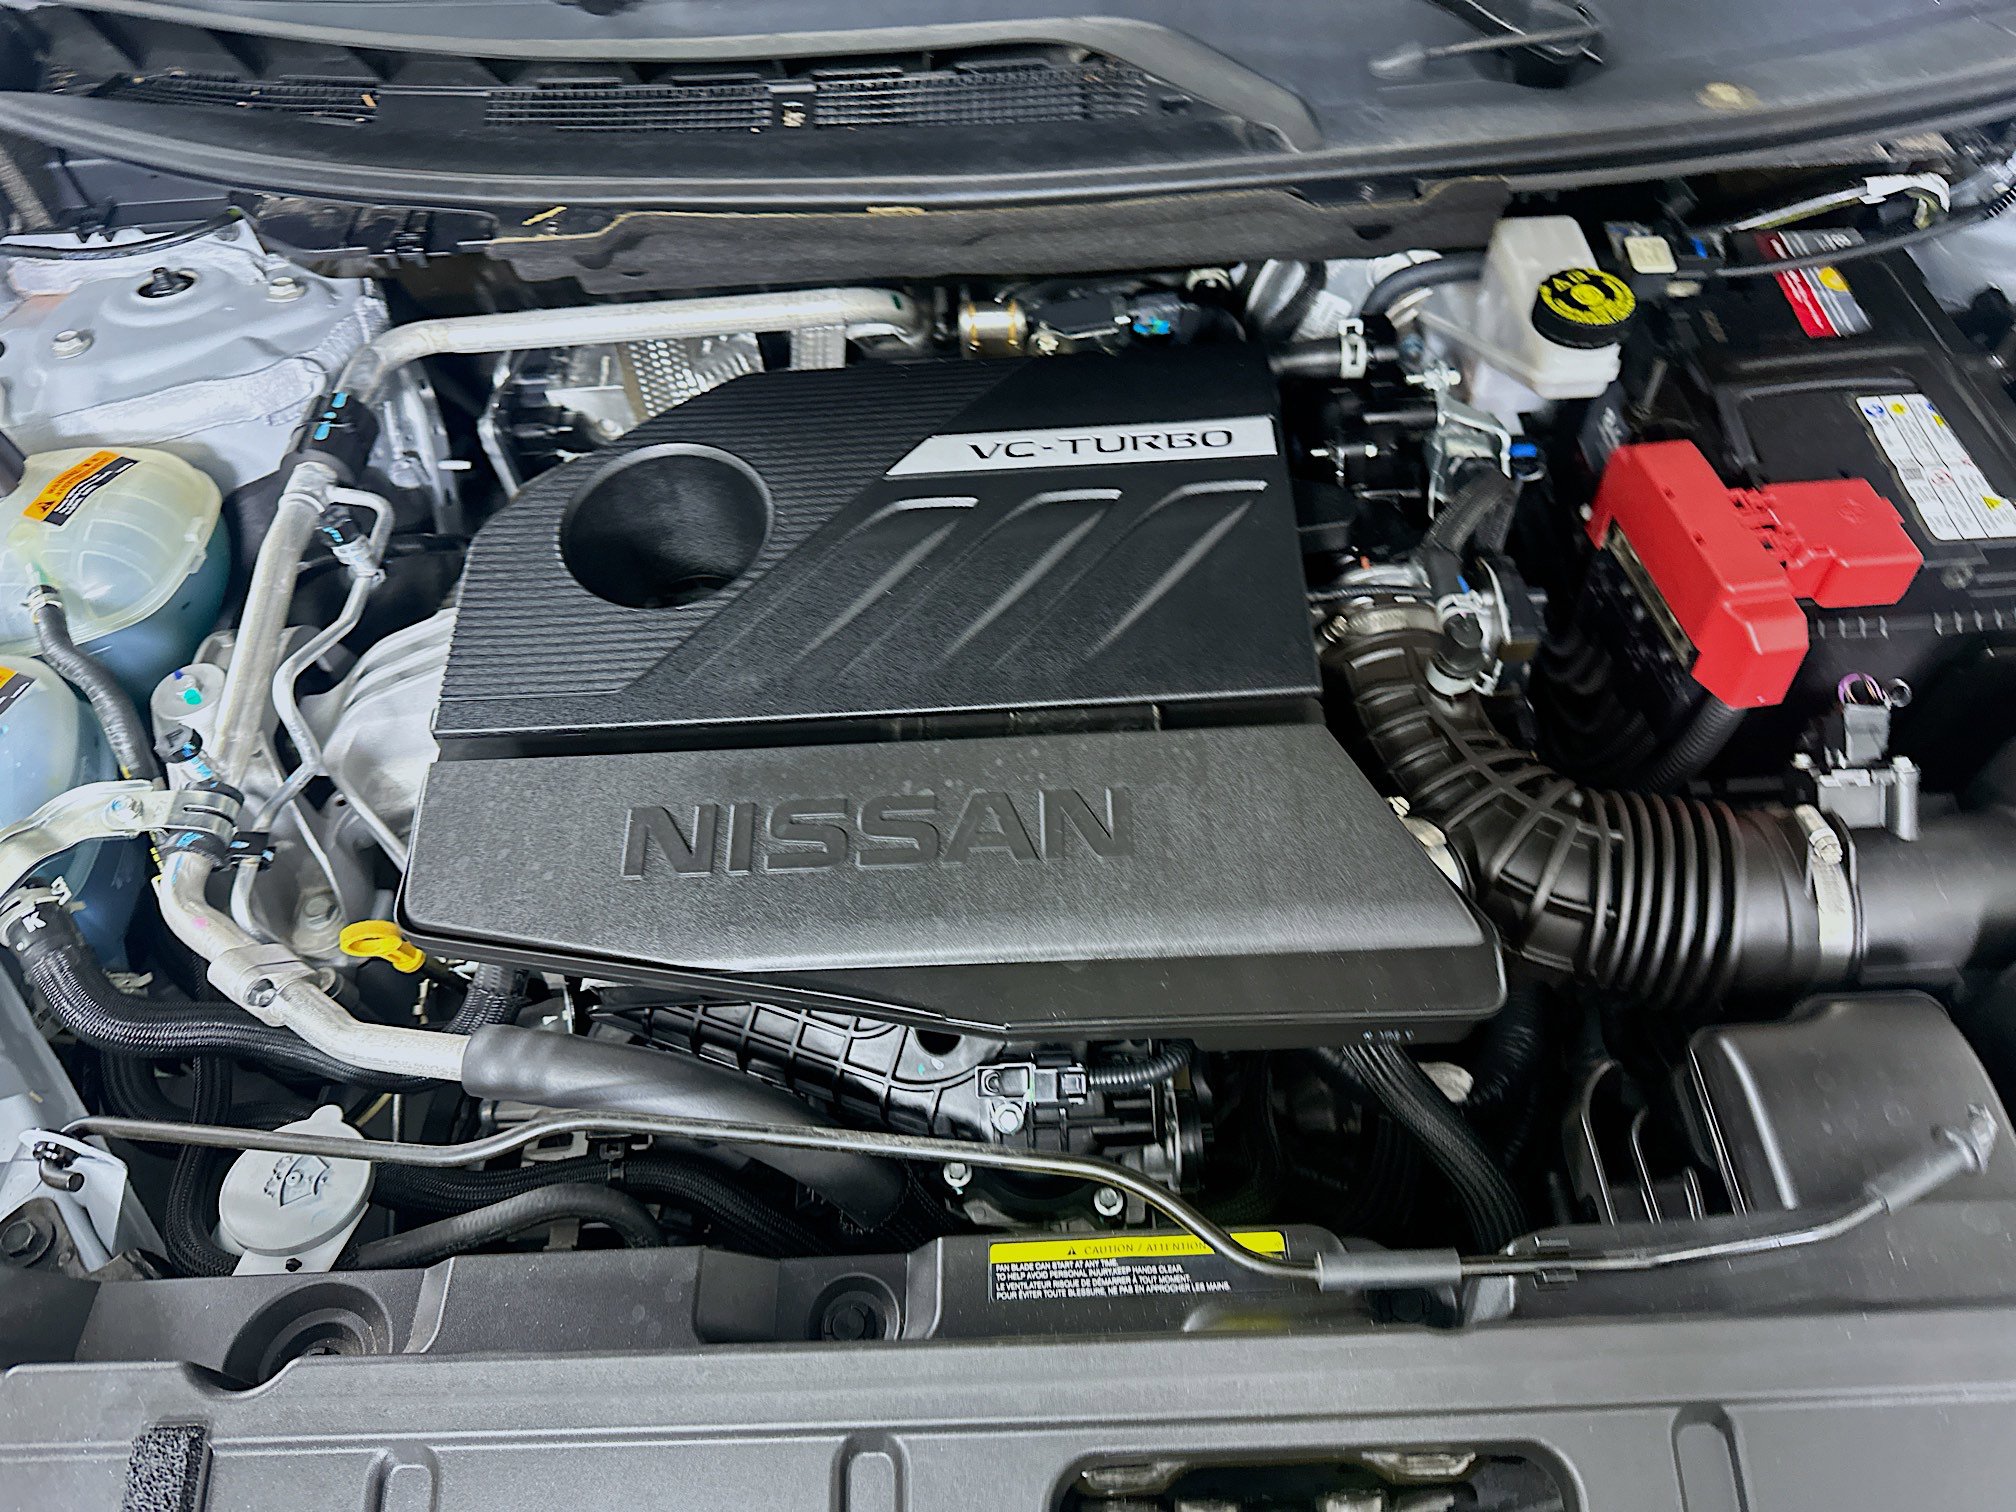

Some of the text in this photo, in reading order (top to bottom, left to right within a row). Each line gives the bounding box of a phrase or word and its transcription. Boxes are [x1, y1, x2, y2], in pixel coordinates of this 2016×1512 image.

[968, 428, 1234, 460] VC-TURBO
[620, 785, 1135, 882] NISSAN
[1084, 1243, 1133, 1255] CAUTION
[1146, 1241, 1206, 1252] ATTENTION
[996, 1272, 1006, 1281] TO
[1007, 1271, 1026, 1281] HELP
[1026, 1270, 1049, 1280] AVOID
[1050, 1268, 1088, 1279] PERSONAL
[1131, 1264, 1157, 1275] HANDS
[1010, 1262, 1034, 1272] BLADE
[1035, 1261, 1051, 1271] CAN
[1051, 1260, 1074, 1271] START
[1074, 1259, 1084, 1269] AT
[1084, 1259, 1100, 1269] ANY
[996, 1282, 1005, 1291] LE
[1006, 1280, 1052, 1291] VENTILATEUR
[1053, 1278, 1080, 1289] RISQUE
[1080, 1277, 1091, 1288] DE
[1138, 1274, 1158, 1285] TOUT
[996, 1291, 1018, 1300] POUR
[1043, 1288, 1067, 1299] TOUTE
[1107, 1285, 1118, 1296] NE
[1118, 1284, 1133, 1295] PAS
[1134, 1283, 1145, 1295] EN
[1145, 1282, 1190, 1294] APPROCHER
[1190, 1281, 1205, 1292] LES
